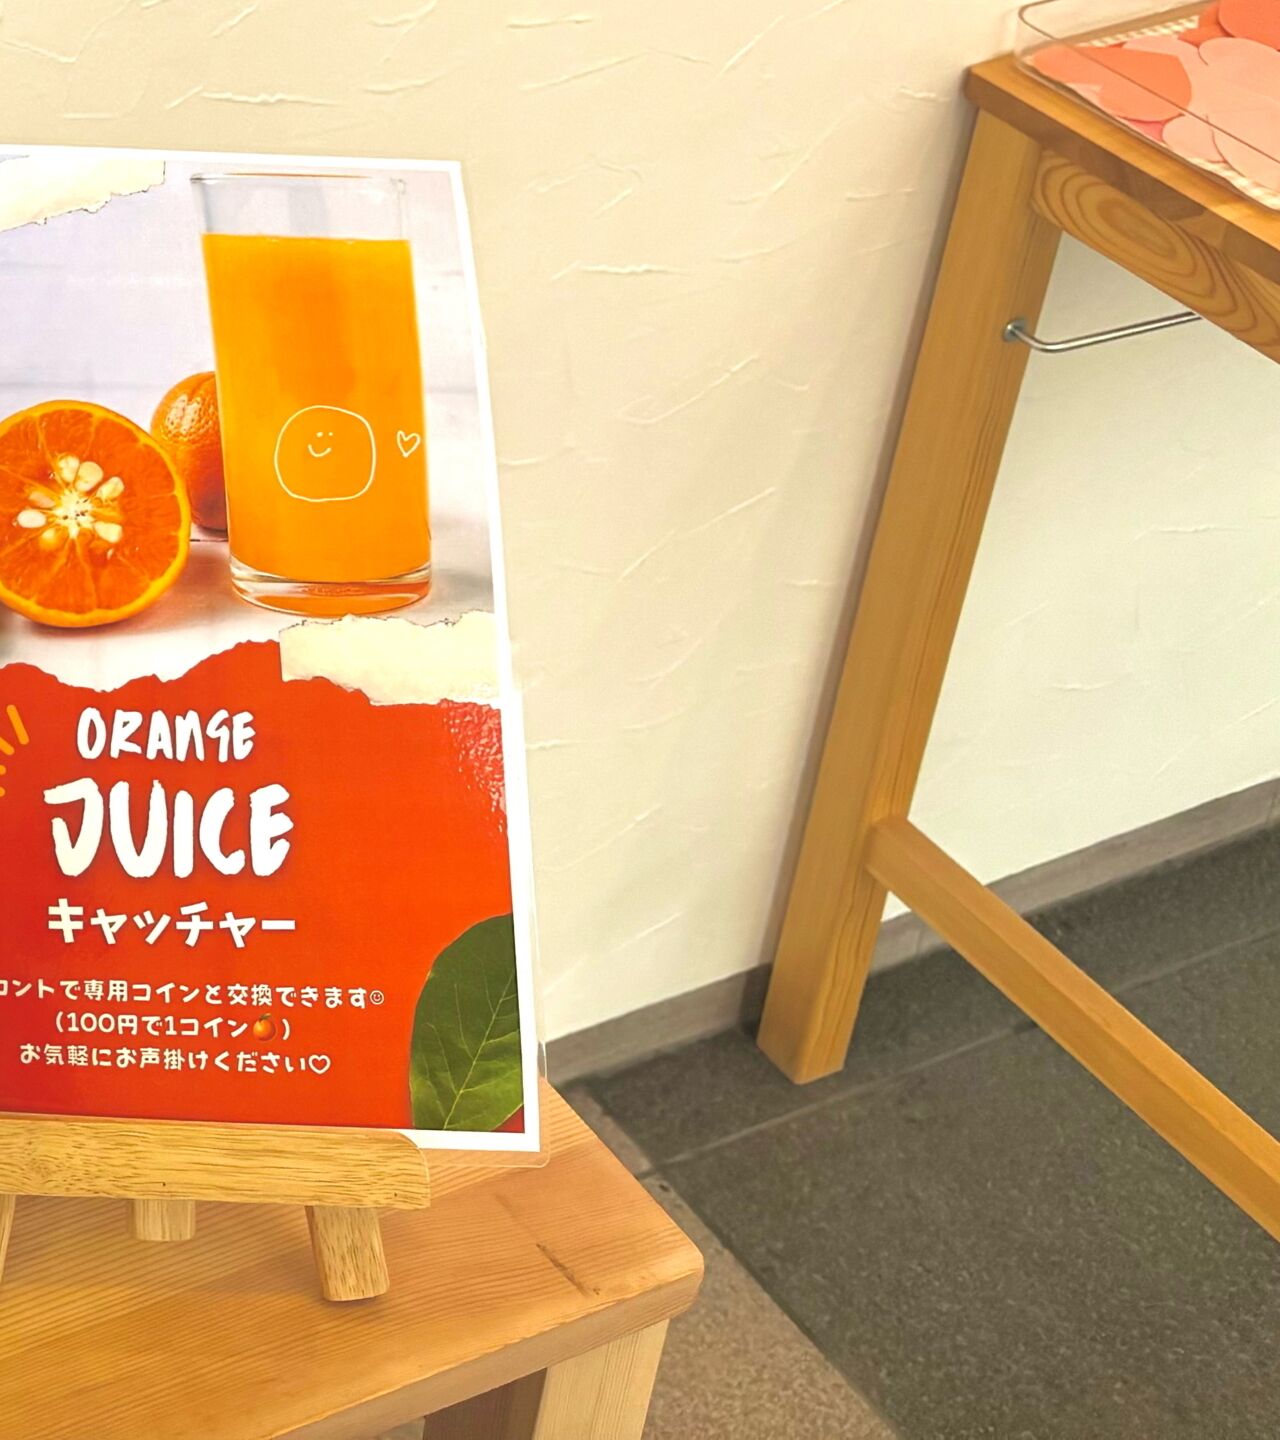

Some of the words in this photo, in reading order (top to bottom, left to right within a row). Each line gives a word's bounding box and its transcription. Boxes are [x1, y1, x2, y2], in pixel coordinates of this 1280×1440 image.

[76, 707, 256, 762] ORANGE
[43, 777, 294, 878] JUICE
[47, 898, 296, 948] キャッチャー
[19, 1042, 308, 1075] お気軽にお声掛けください
